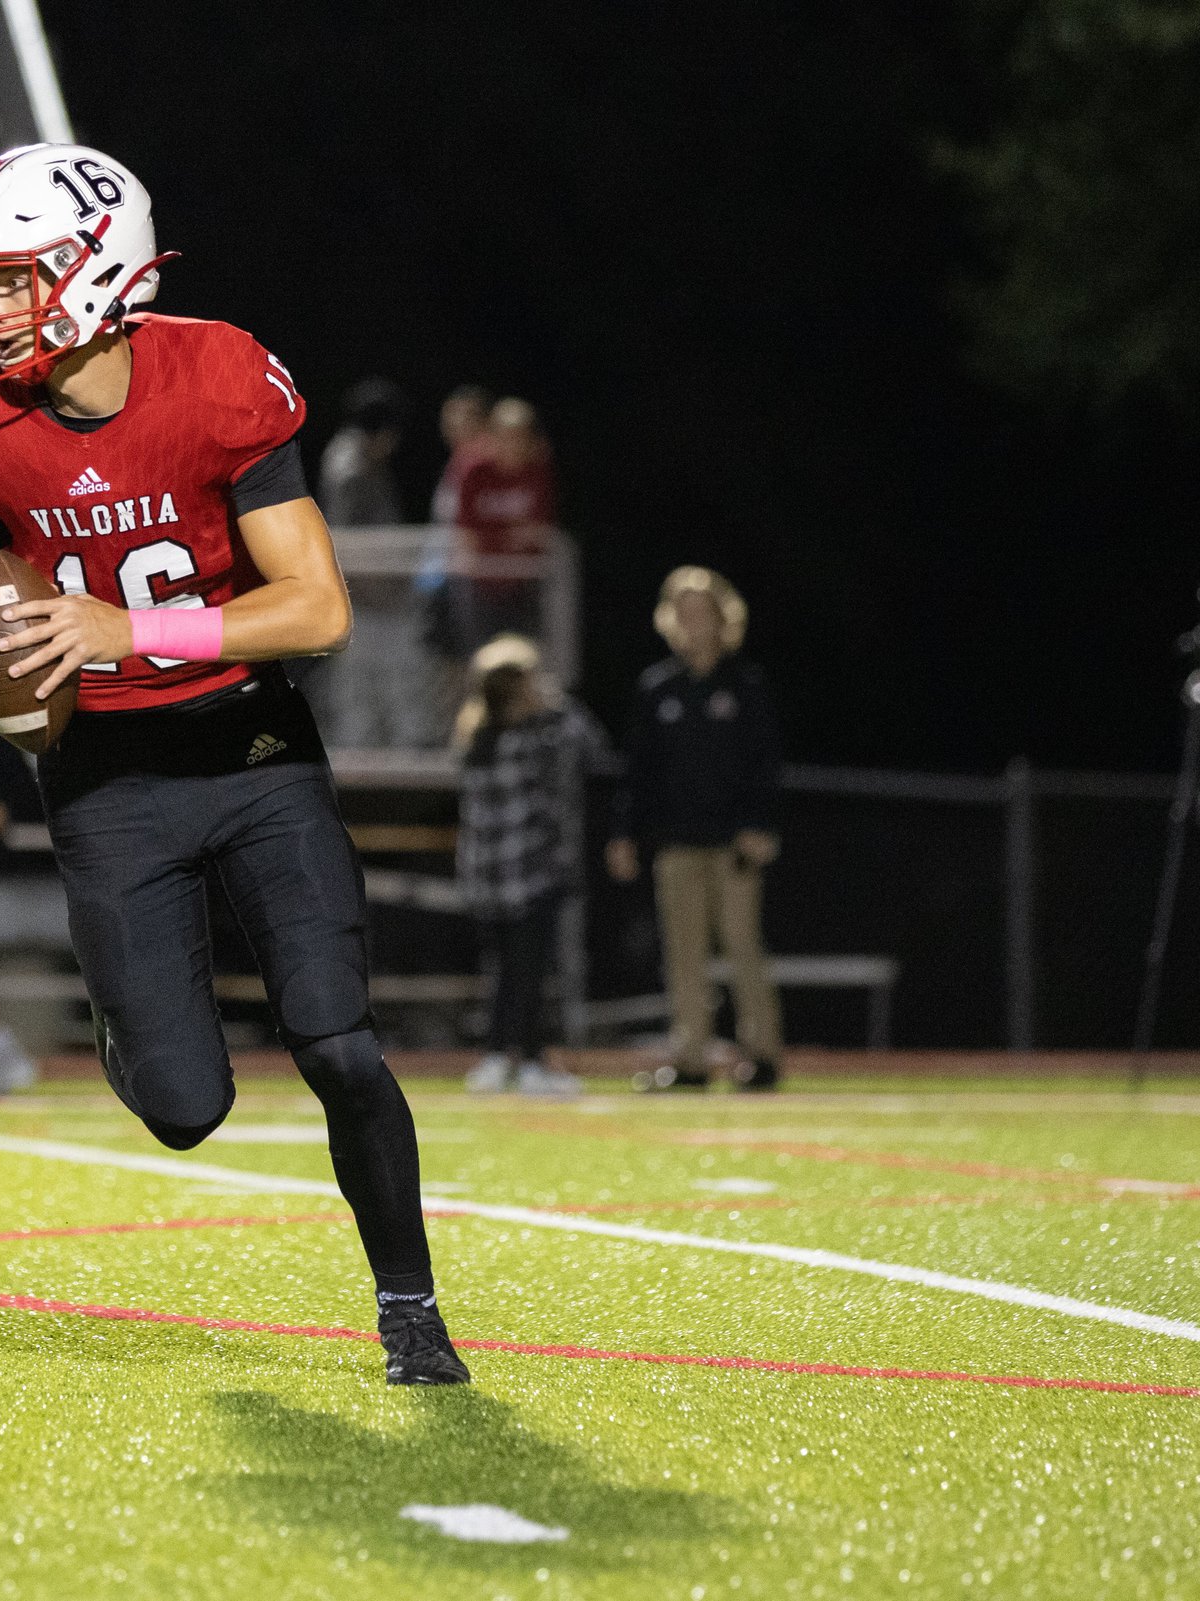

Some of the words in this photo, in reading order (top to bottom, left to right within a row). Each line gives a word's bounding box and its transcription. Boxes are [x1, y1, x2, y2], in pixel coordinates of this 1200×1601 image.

[49, 158, 124, 224] 16
[68, 482, 111, 496] adidas
[29, 492, 179, 538] VILONIA
[246, 740, 287, 765] adidas
